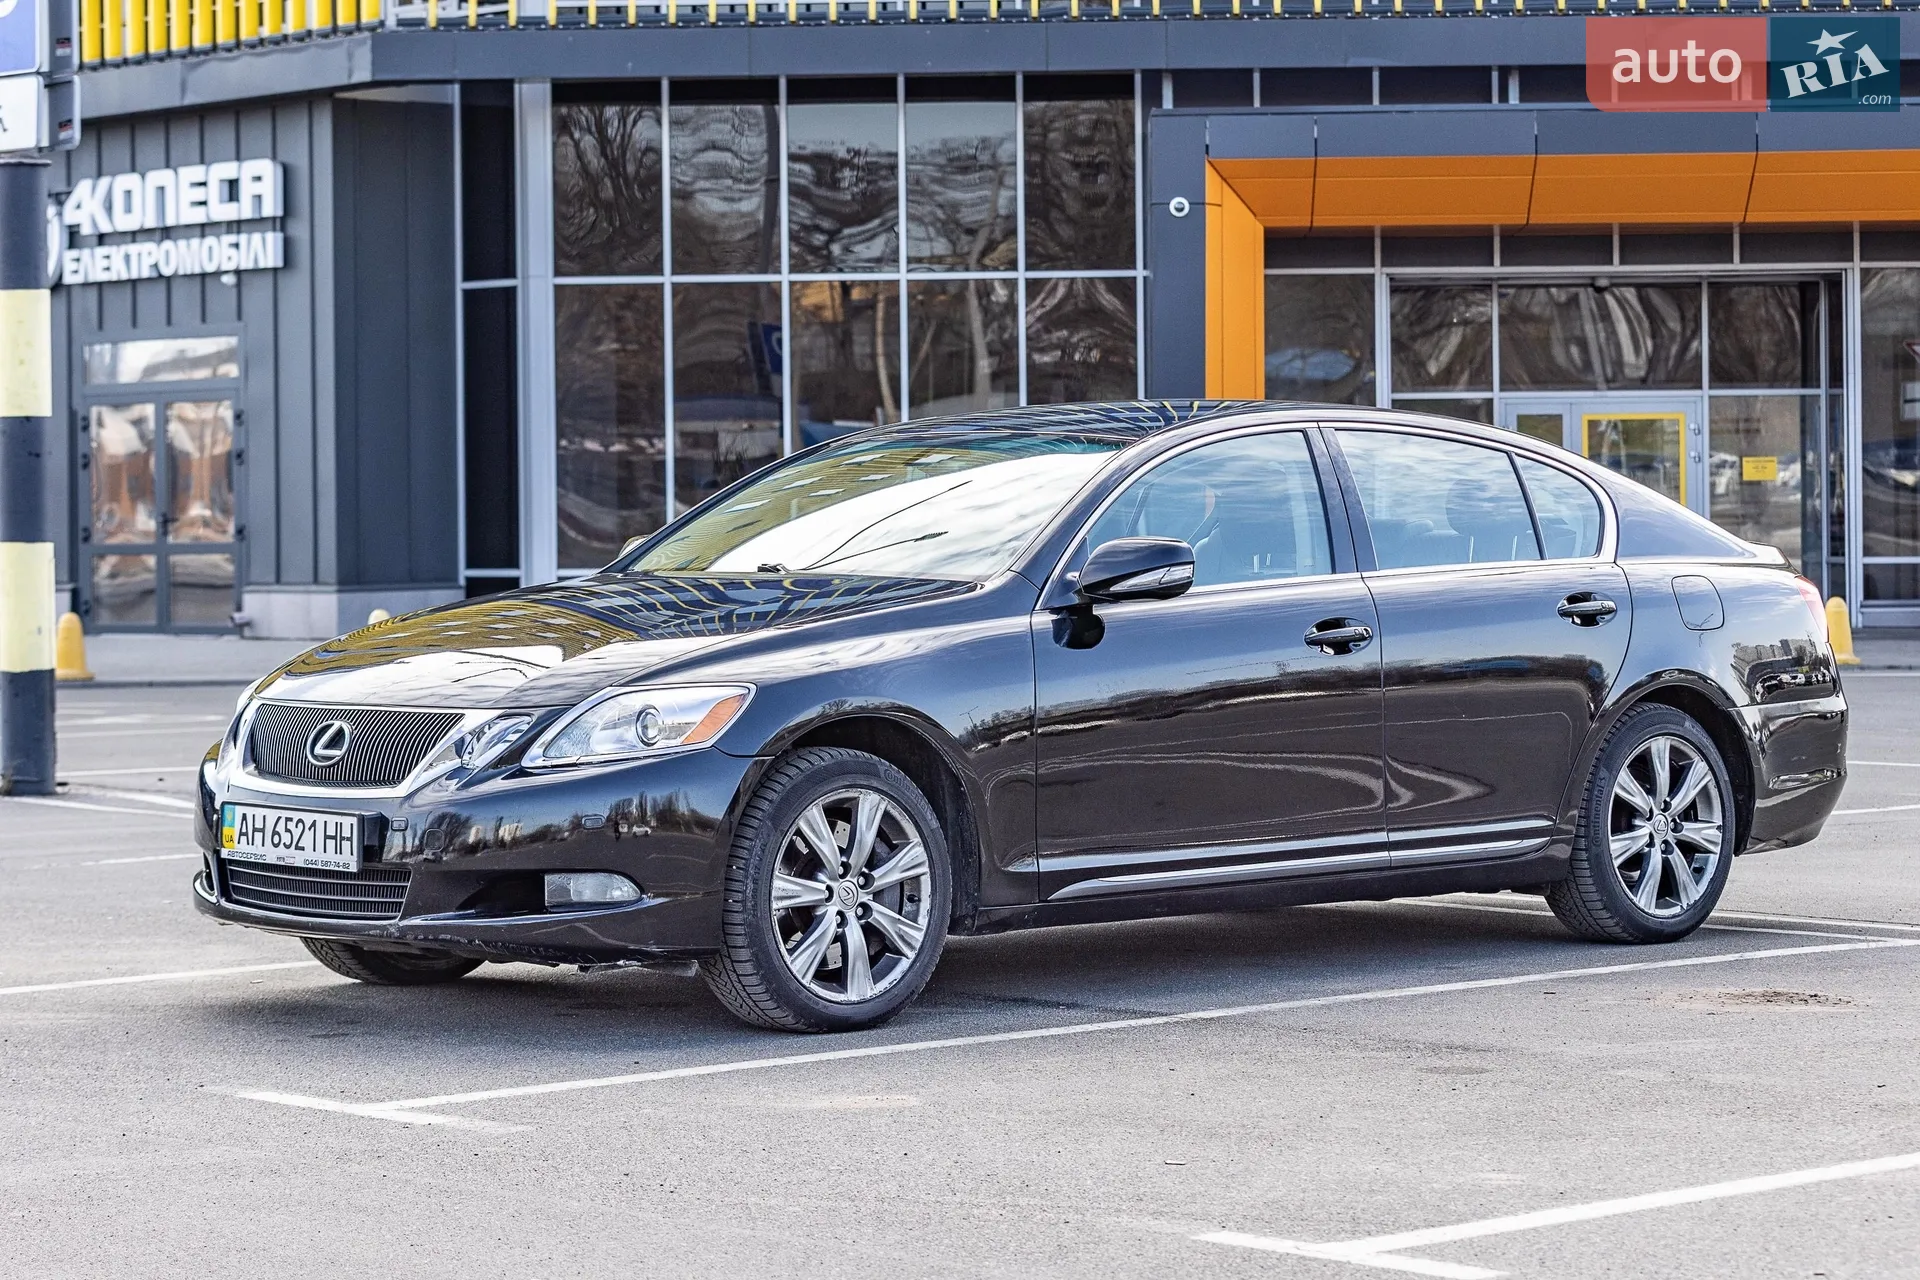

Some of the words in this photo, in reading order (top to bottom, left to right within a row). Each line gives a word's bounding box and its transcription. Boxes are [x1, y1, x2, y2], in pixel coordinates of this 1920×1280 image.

[62, 231, 278, 286] ЕЛЕКТРОМОБІЛІ
[224, 834, 235, 844] UA
[237, 812, 266, 847] AH
[270, 815, 317, 853] 6521
[323, 820, 354, 856] HH
[303, 858, 319, 867] (044)
[320, 860, 351, 870] 587-74-82
